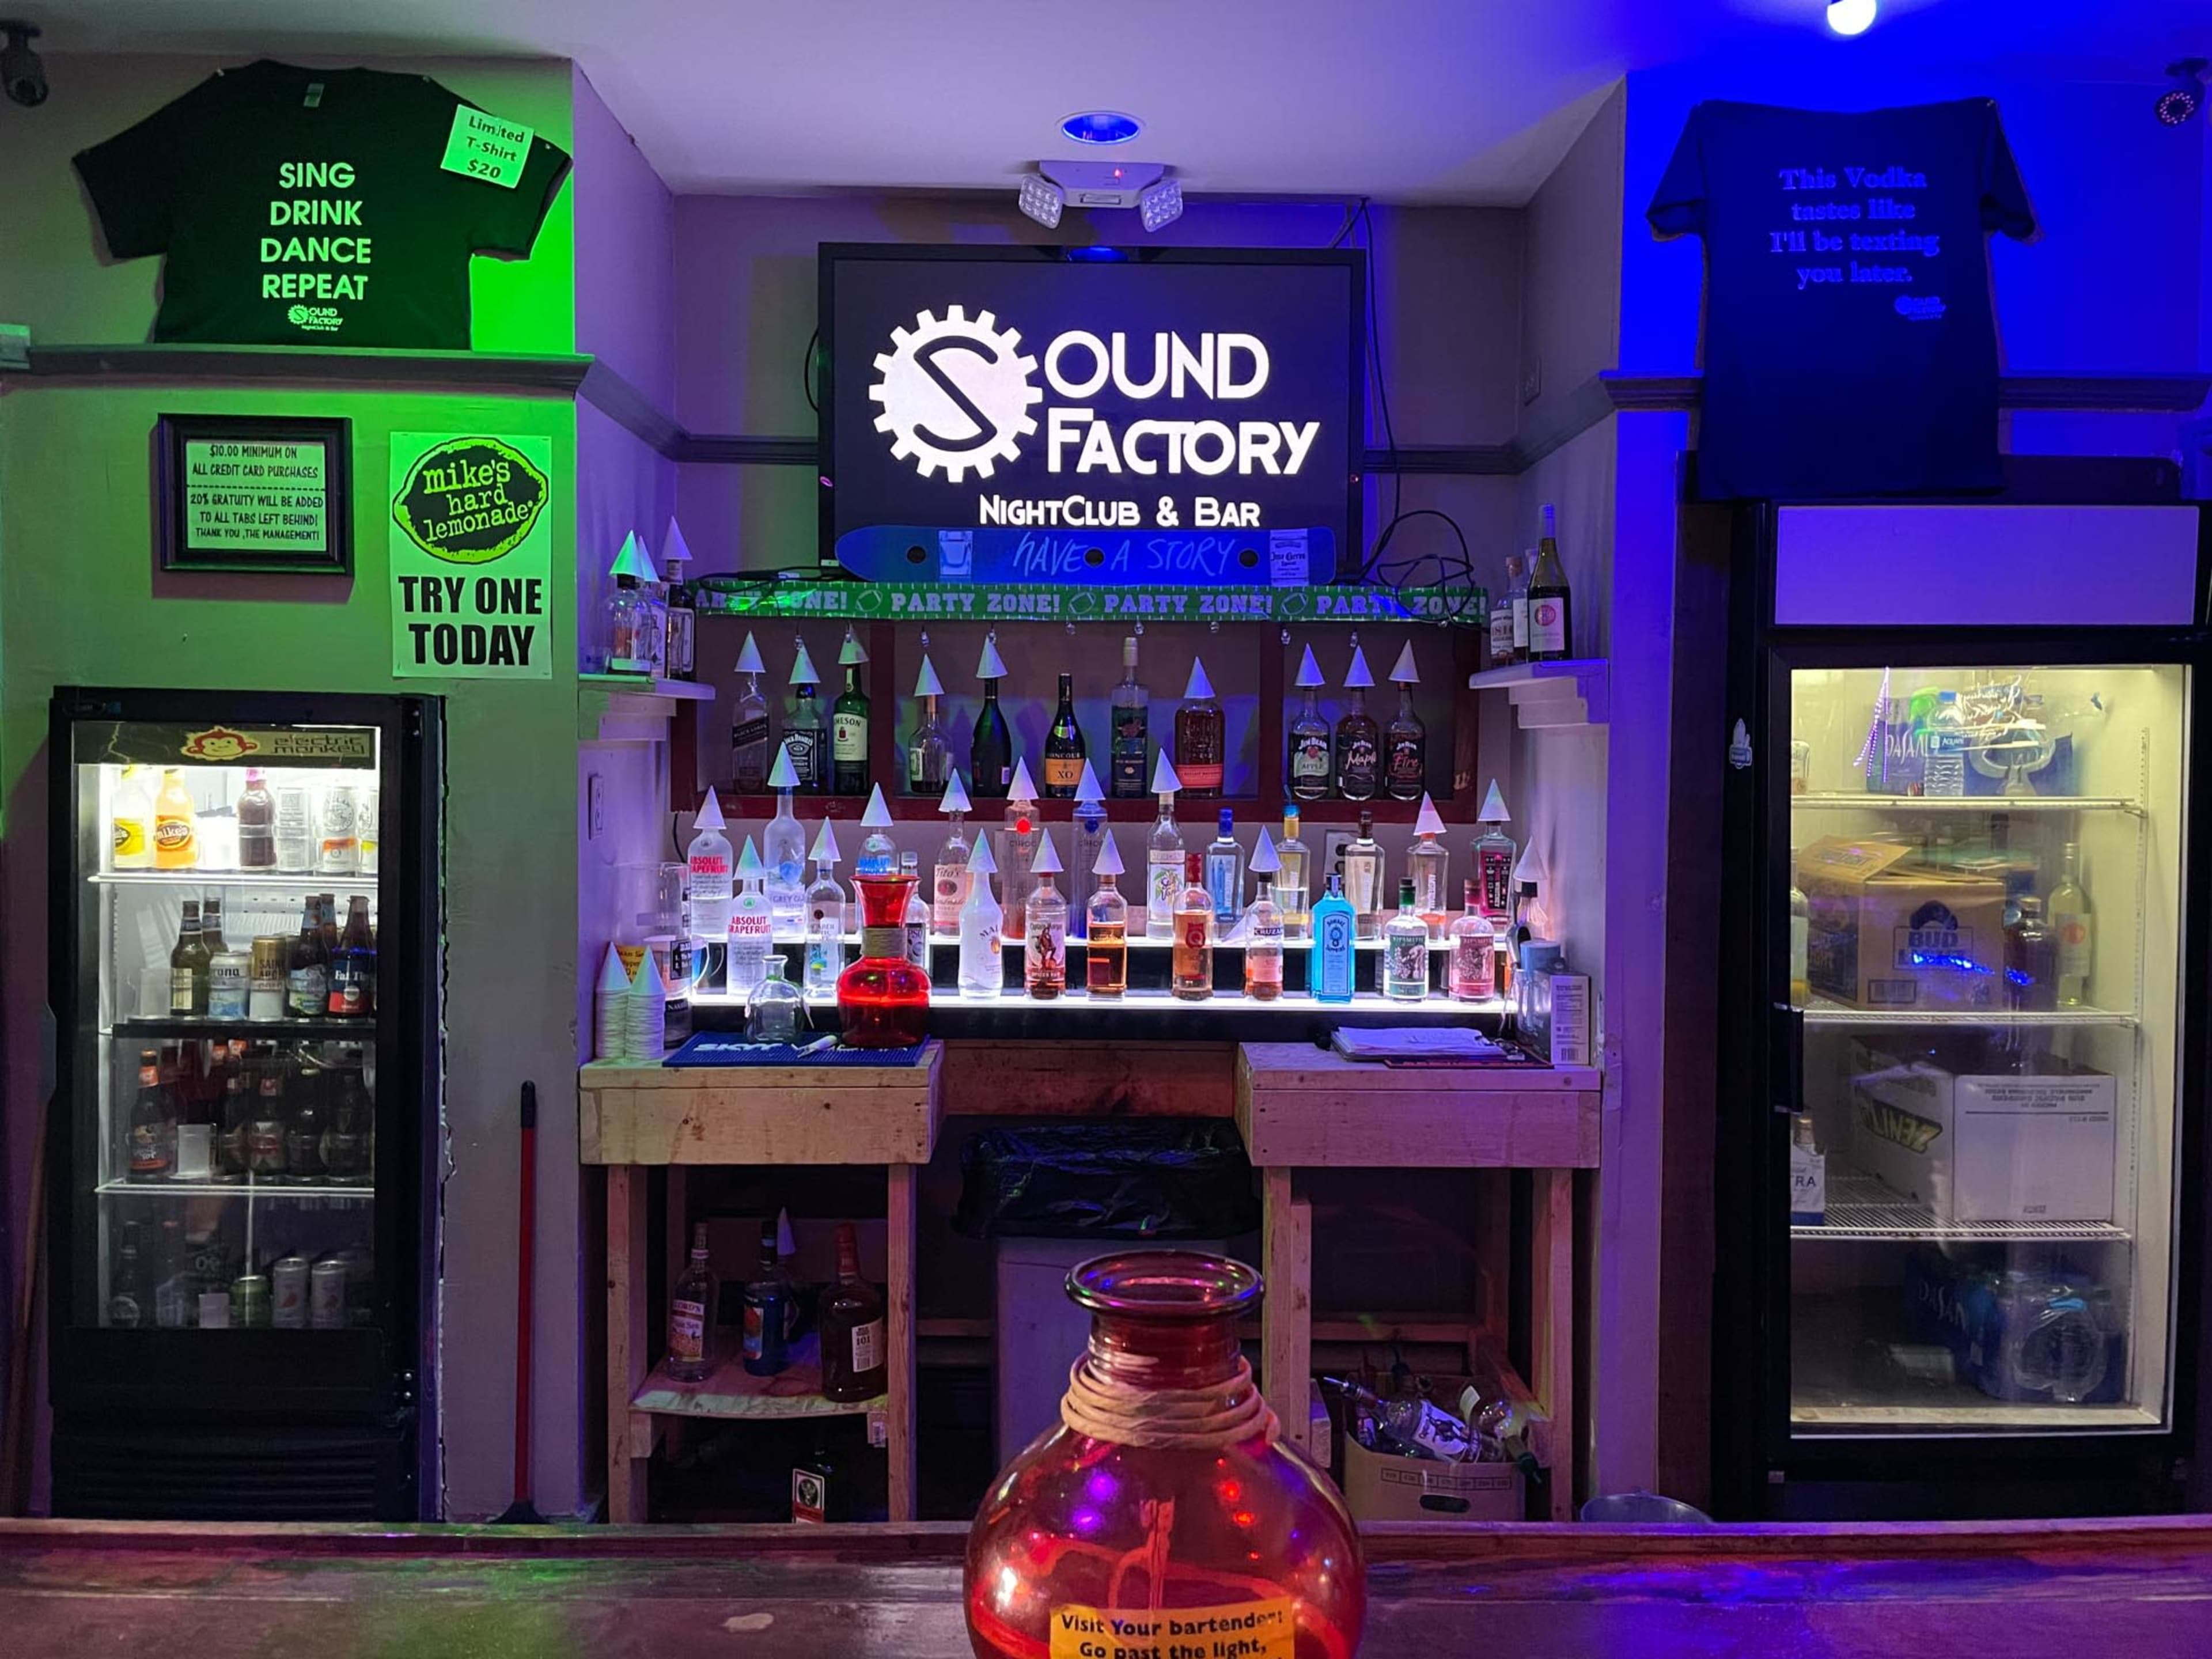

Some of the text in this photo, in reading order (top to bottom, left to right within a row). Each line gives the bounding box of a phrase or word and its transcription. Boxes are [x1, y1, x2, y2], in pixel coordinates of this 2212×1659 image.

[468, 115, 525, 143] Limited
[466, 136, 517, 162] T-Shirt
[279, 162, 355, 188] SING
[467, 158, 502, 179] $20
[1779, 166, 1927, 190] This Vodka
[271, 200, 362, 226] DRINK
[1791, 198, 1916, 221] tastes like
[261, 237, 372, 263] DANCE
[1769, 230, 1940, 257] I'll be texting
[263, 274, 368, 300] REPEAT
[1797, 261, 1912, 290] you later.
[210, 445, 297, 459] $10.00 MINIMUM ON
[1047, 407, 1320, 476] FACTORY
[192, 463, 318, 478] ALL CREDIT CARD PURCHASES
[423, 460, 511, 495] mike's
[190, 493, 324, 508] 20% GRATUITY WILL BE ADDED
[446, 483, 508, 516] hard
[1156, 497, 1179, 527] &
[1195, 497, 1260, 527] BAR
[199, 511, 211, 522] TO
[214, 512, 230, 523] ALL
[233, 512, 256, 524] TABS
[259, 513, 281, 525] LEFT
[423, 501, 530, 542] lemonade
[196, 528, 221, 537] THANK
[225, 528, 240, 538] YOU
[1111, 539, 1131, 572] A
[1147, 536, 1235, 576] STORY
[398, 575, 543, 615] TRY ONE
[891, 593, 1060, 613] PARTY ZONE!
[1104, 594, 1272, 615] PARTY ZONE!
[408, 623, 536, 666] TODAY
[1058, 771, 1073, 779] XO
[732, 916, 767, 925] ABSOLUT
[857, 1336, 870, 1346] 101
[1061, 1615, 1104, 1633] Visit
[1111, 1619, 1161, 1636] Your
[1080, 1642, 1107, 1659] Go
[1169, 1643, 1206, 1659] the
[1214, 1639, 1267, 1659] light,
